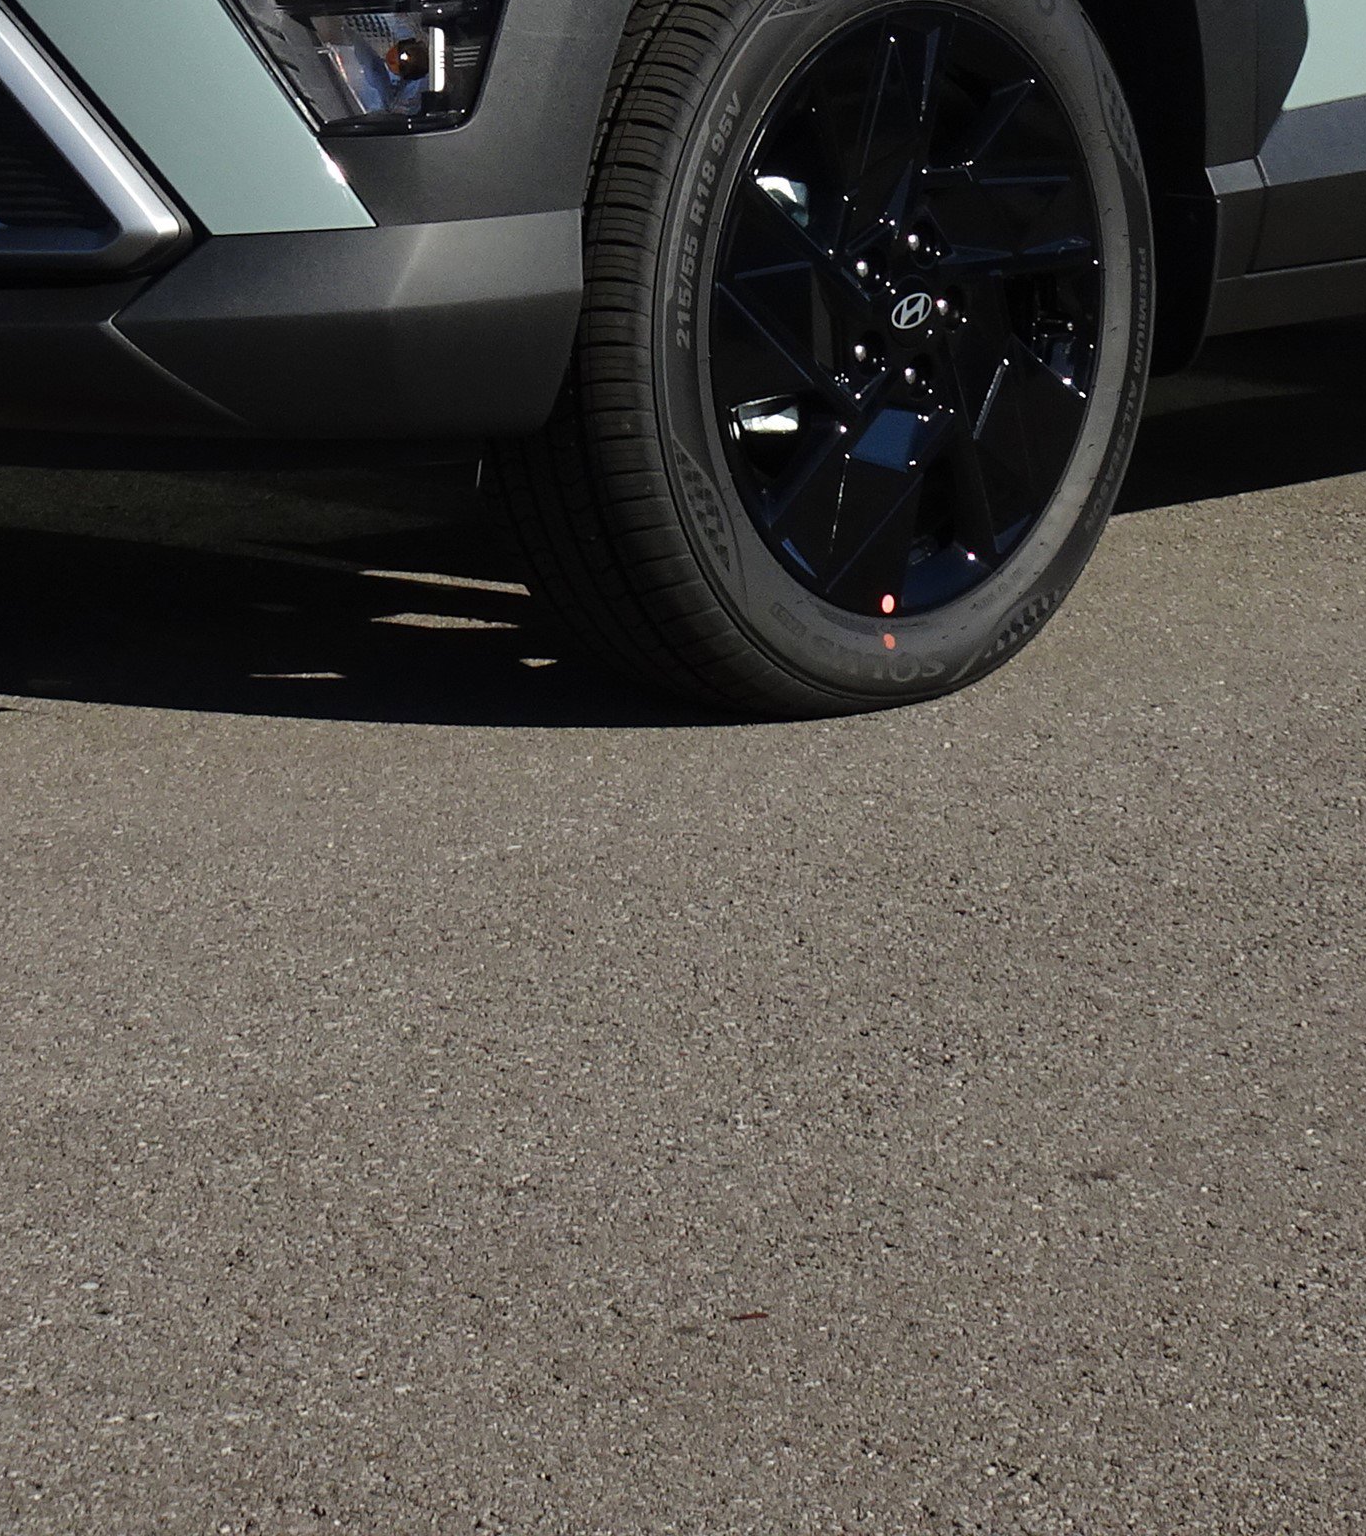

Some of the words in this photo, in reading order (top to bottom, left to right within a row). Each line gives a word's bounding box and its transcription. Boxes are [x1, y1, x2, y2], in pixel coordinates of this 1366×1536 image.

[676, 234, 700, 350] 215/55
[689, 159, 717, 227] R18
[710, 89, 743, 157] 95V
[1132, 246, 1147, 375] PREMIUM
